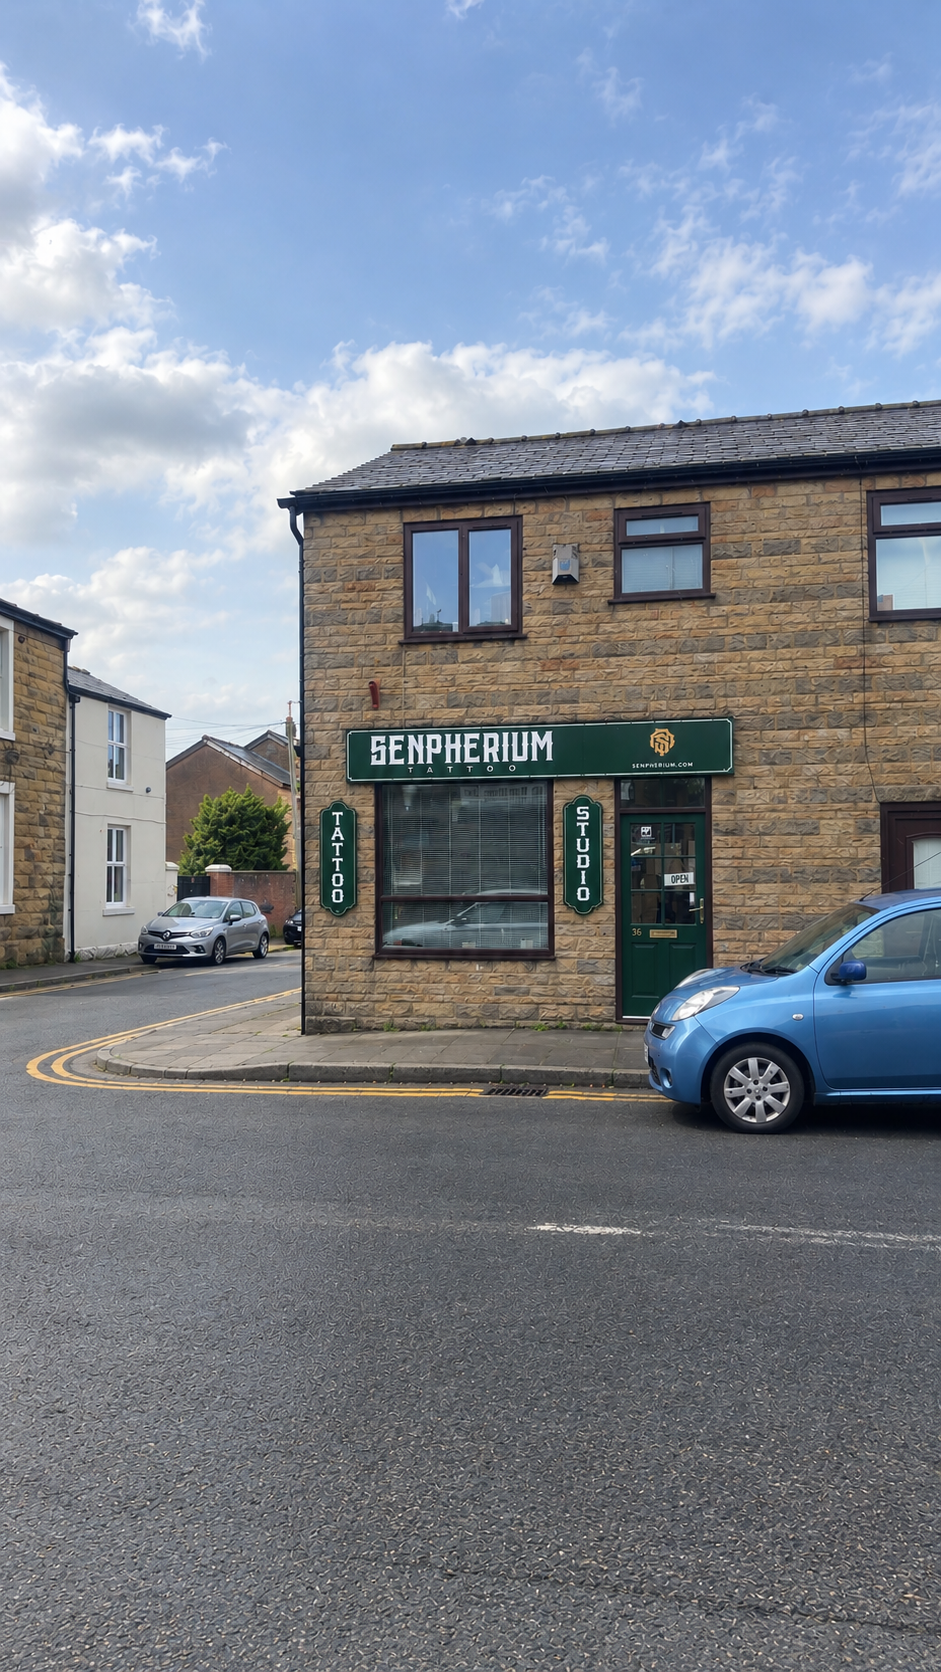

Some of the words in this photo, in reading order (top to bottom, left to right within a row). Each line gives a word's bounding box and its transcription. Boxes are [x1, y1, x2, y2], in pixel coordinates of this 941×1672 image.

[370, 730, 554, 765] SENPHERIUM
[408, 764, 516, 774] TATTOO
[331, 812, 344, 903] TATTOO
[576, 806, 590, 901] STUDIO
[671, 874, 689, 884] OPEN
[632, 928, 642, 936] 36
